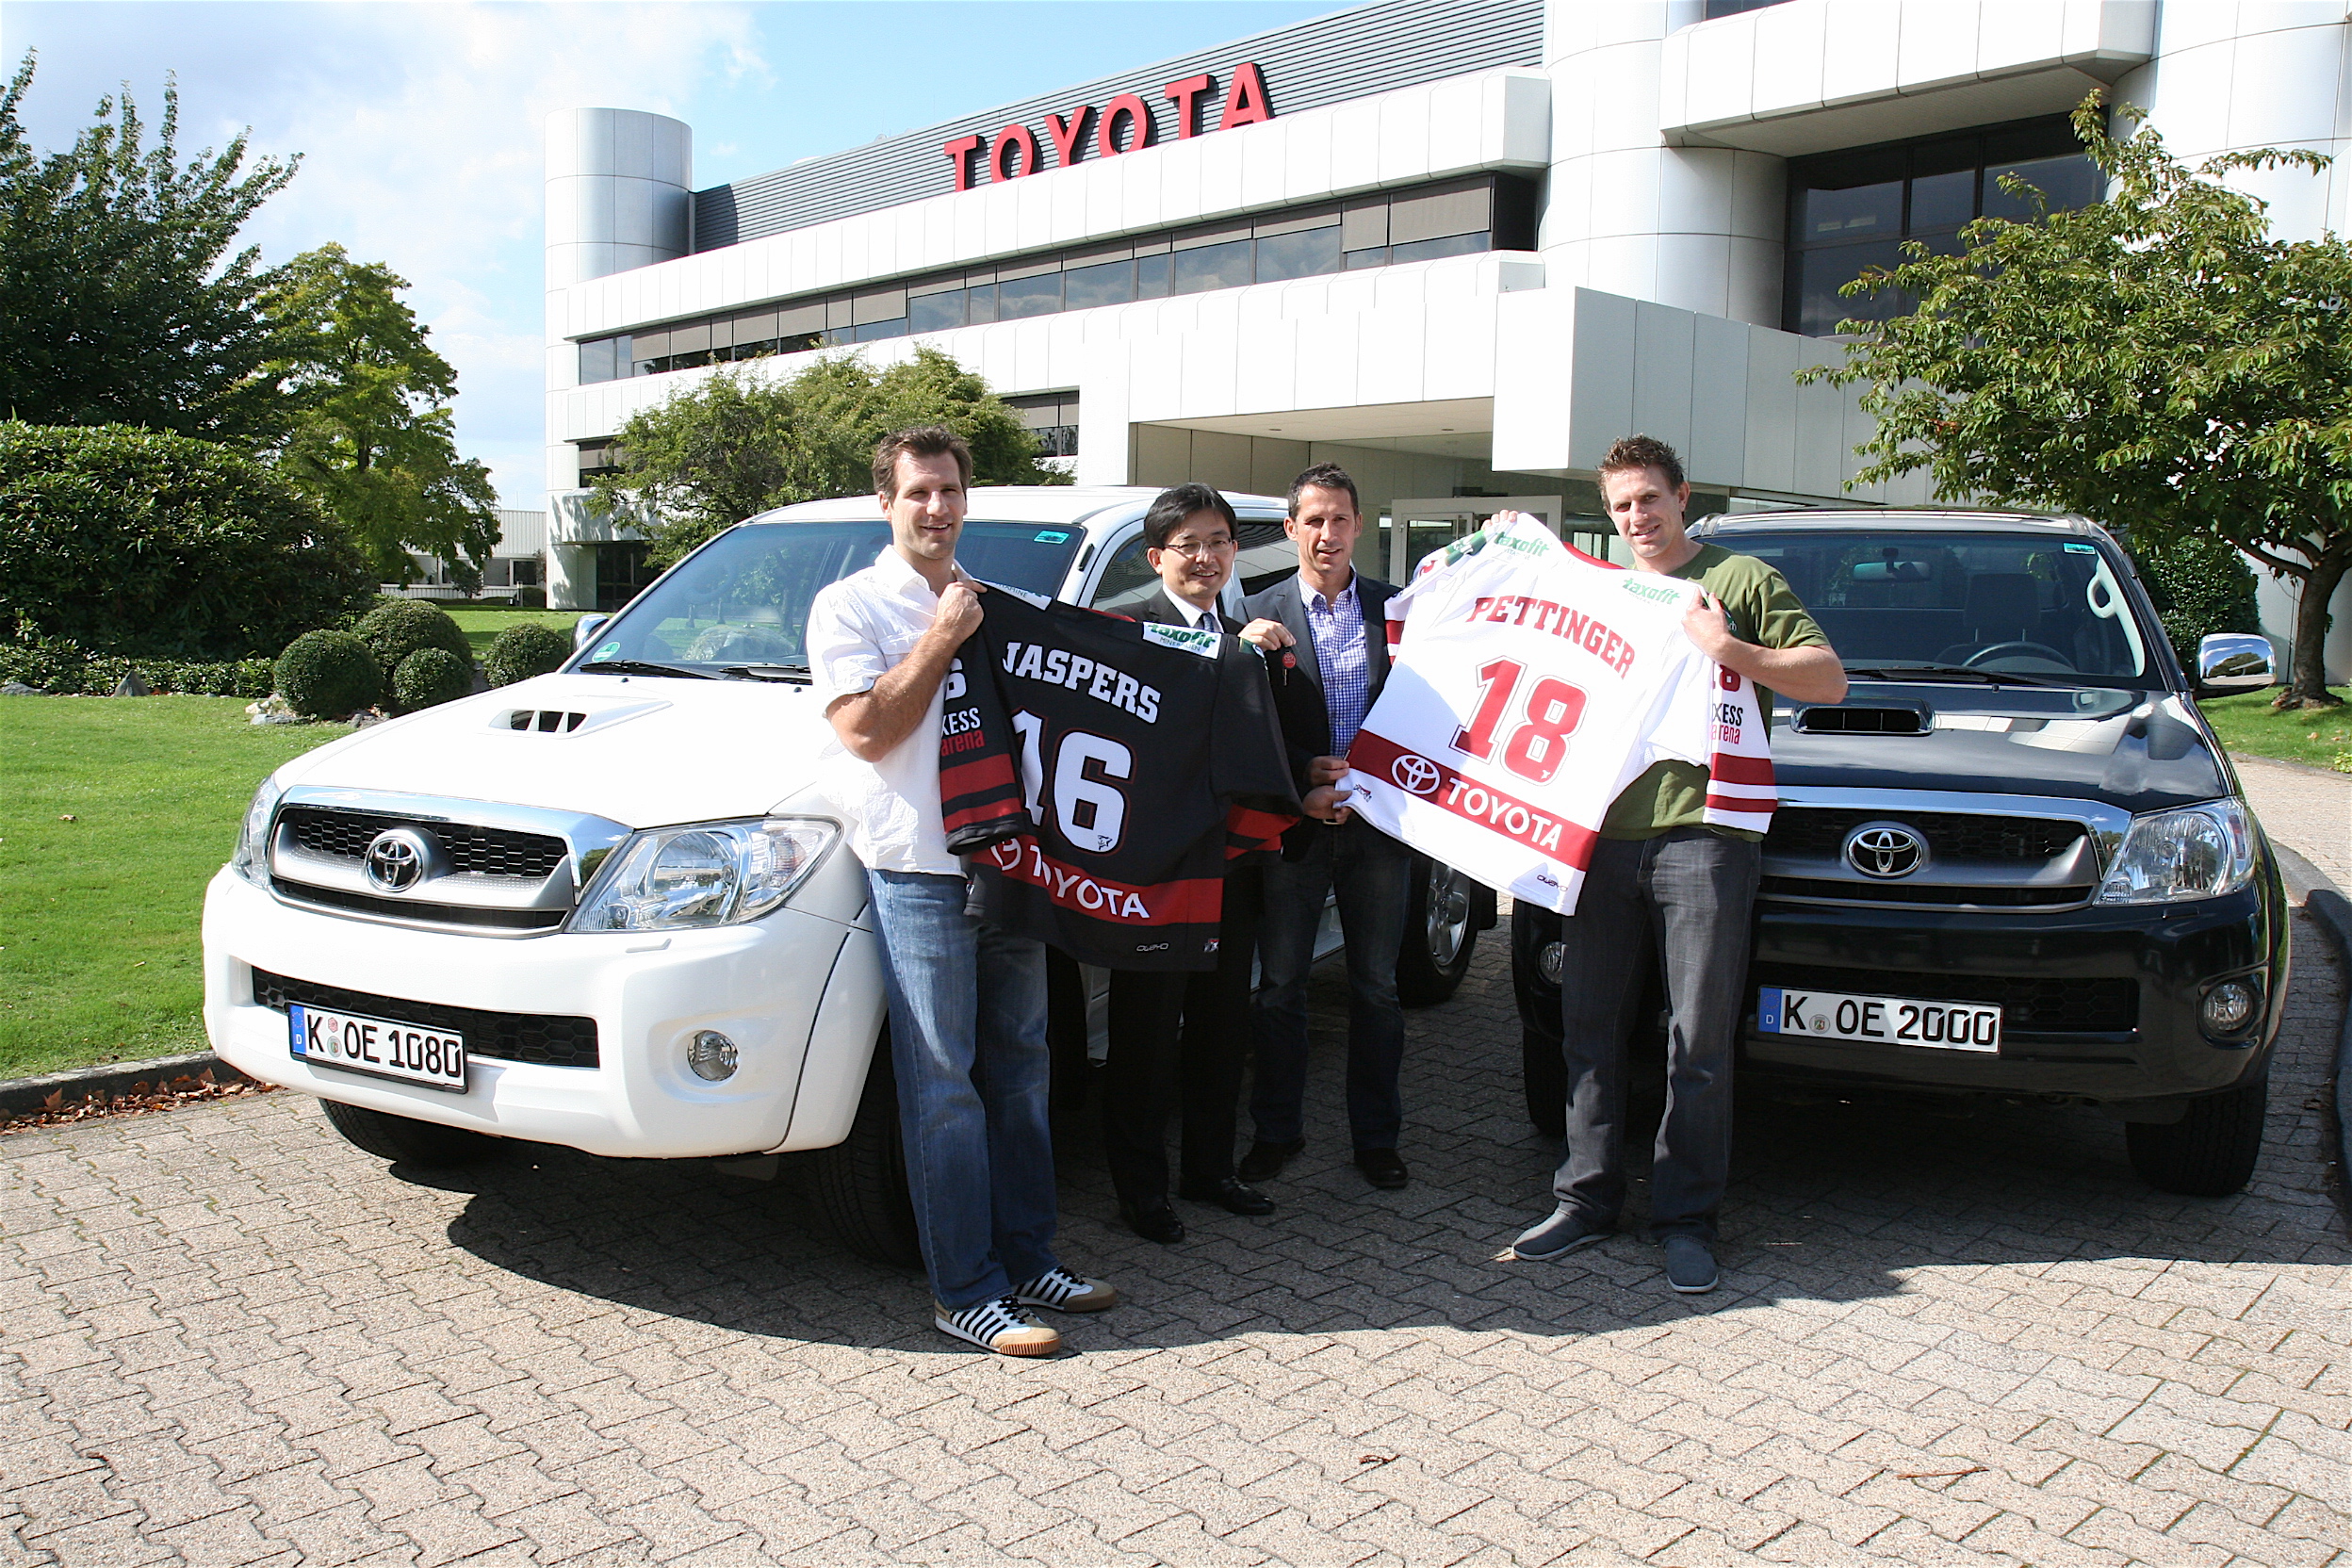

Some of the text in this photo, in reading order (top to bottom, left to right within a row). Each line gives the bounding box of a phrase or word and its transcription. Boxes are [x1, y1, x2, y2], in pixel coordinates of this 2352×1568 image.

[943, 61, 1270, 193] TOYOTA
[1493, 531, 1550, 558] taxofit
[1622, 577, 1681, 605] taxofit
[1147, 623, 1217, 648] taxofit
[1465, 595, 1635, 679] PETTINGER
[1002, 642, 1161, 724] JASPERS
[940, 729, 986, 757] arena
[1449, 656, 1590, 785] 18
[1011, 709, 1133, 853] 16
[1447, 776, 1563, 852] TOYOTA
[295, 1033, 302, 1045] D
[307, 1014, 462, 1078] K OE 1080
[1765, 1014, 1773, 1024] D
[1782, 994, 1996, 1045] K OE 2000
